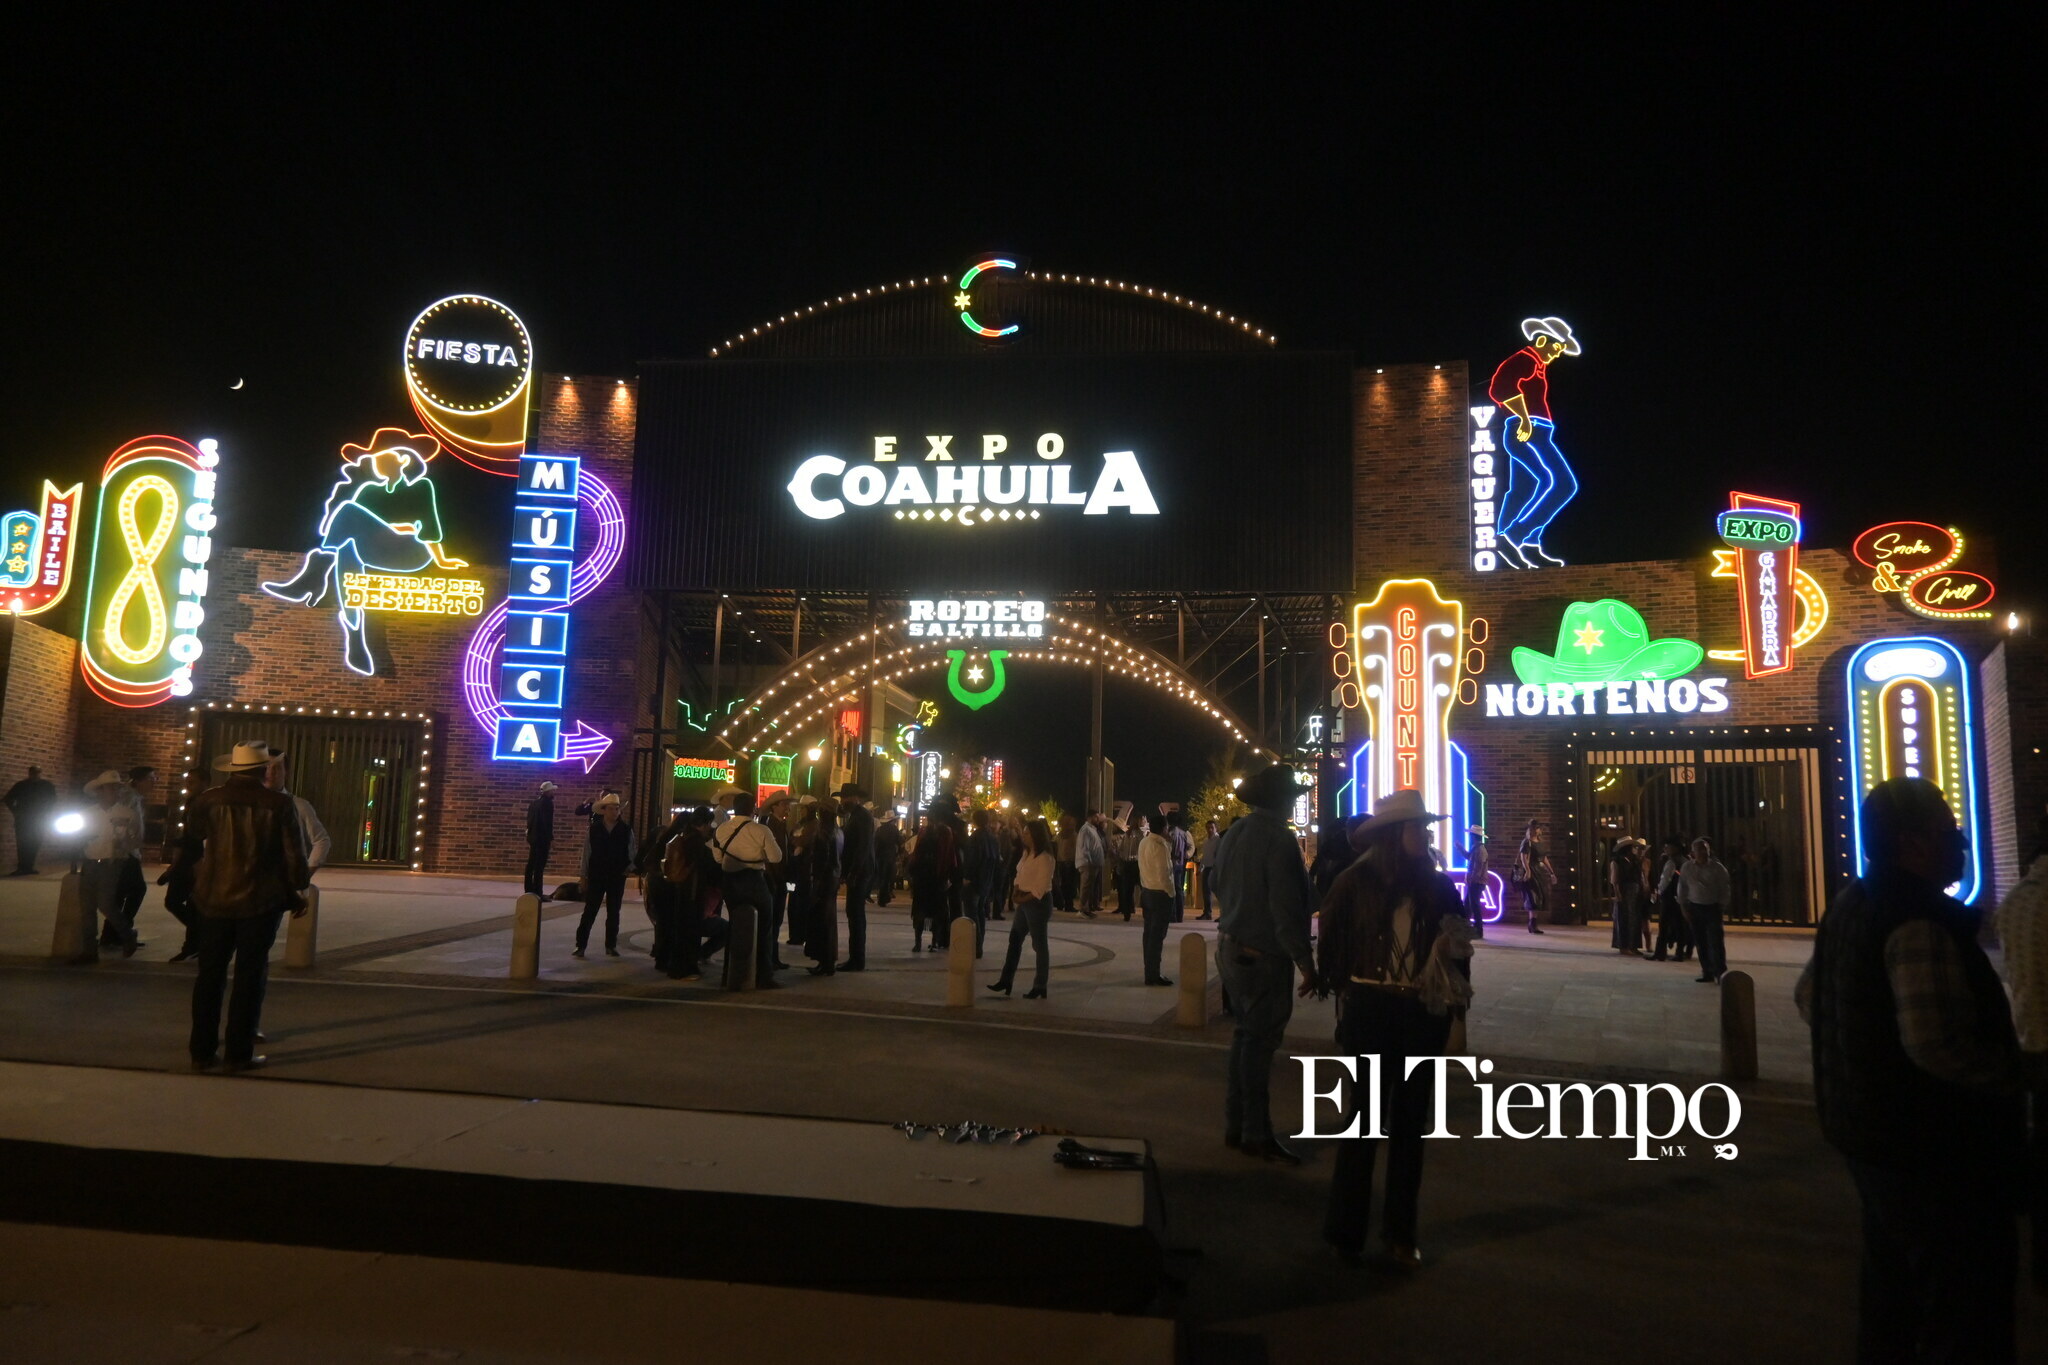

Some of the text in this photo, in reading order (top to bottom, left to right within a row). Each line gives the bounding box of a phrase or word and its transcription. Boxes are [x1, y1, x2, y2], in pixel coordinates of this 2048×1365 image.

[418, 339, 519, 367] FIESTA
[873, 432, 1065, 462] EXPO
[786, 450, 1161, 520] COAHUILA
[1470, 406, 1496, 572] VAQUERO
[43, 503, 68, 586] BAILE
[1724, 517, 1794, 543] EXPO
[1873, 533, 1932, 559] Smoke
[168, 438, 220, 697] SEGUNDOS
[1872, 561, 1903, 593] &
[345, 588, 484, 616] DESIERTO
[447, 578, 485, 596] DEL
[1925, 577, 1978, 605] Grill
[511, 461, 566, 753] MÚSICA
[909, 600, 1045, 622] RODEO
[1758, 551, 1781, 667] GANADERA
[909, 622, 1043, 638] SALTILLO
[1397, 608, 1417, 787] COUNT
